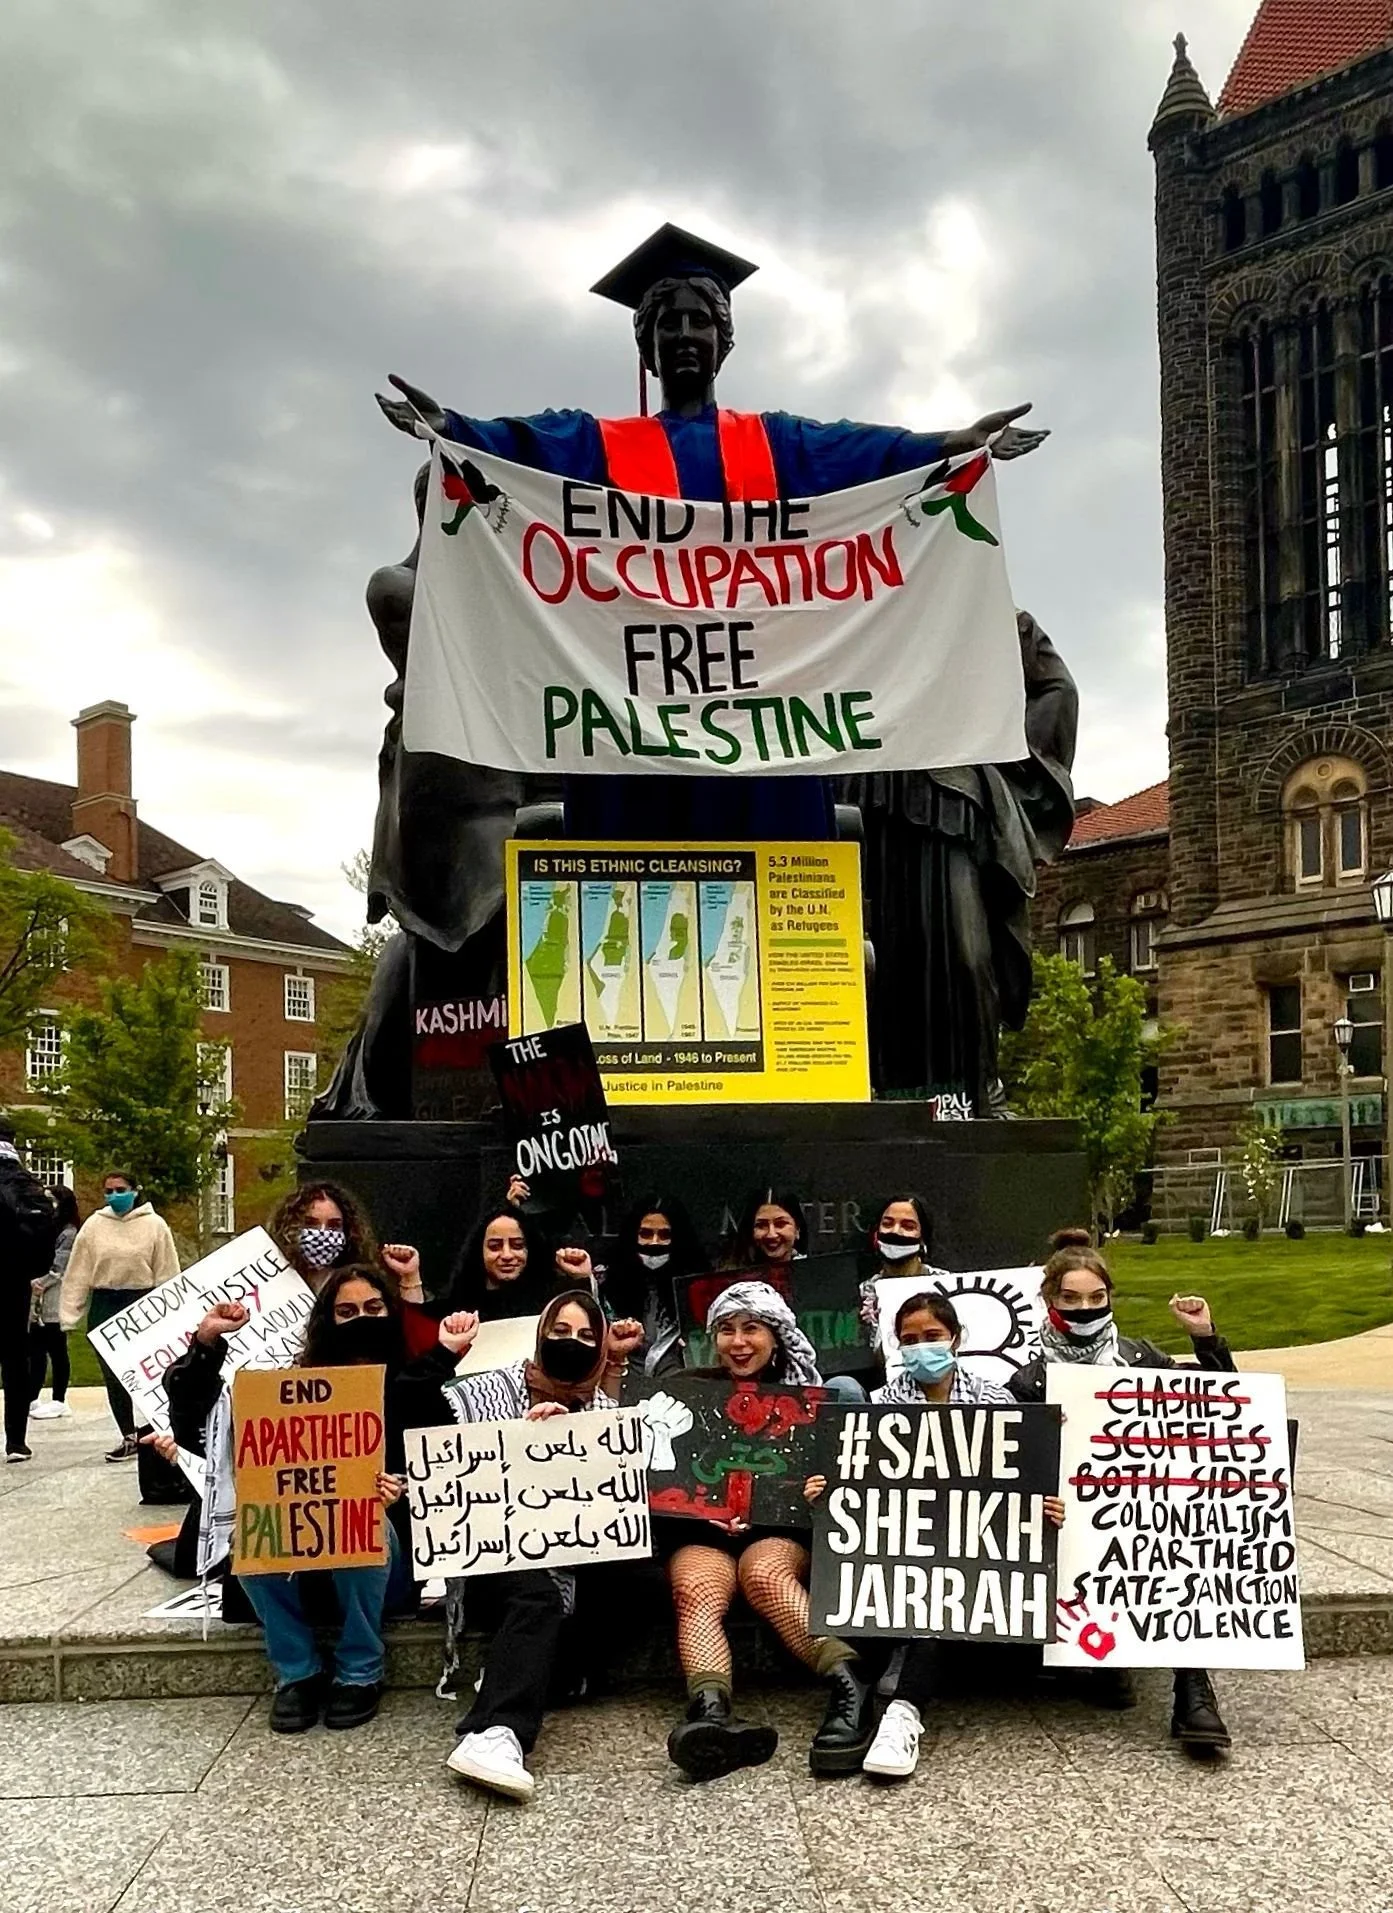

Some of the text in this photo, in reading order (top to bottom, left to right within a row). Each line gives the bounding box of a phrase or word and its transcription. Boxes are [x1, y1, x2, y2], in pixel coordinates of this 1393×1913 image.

[562, 481, 694, 543] END
[523, 522, 904, 608] OCCUPATION
[624, 622, 758, 696] FREE
[544, 686, 882, 764] PALESTINE
[534, 859, 742, 873] IS THIS ETHNIC CLEANSING?
[769, 856, 829, 867] 5.3 Million
[769, 872, 836, 883] Palestinians
[769, 887, 845, 899] are Classified
[770, 904, 831, 917] by the U.N.
[771, 920, 839, 933] as Refugees
[505, 1036, 547, 1063] THE
[621, 1053, 632, 1064] of
[635, 1052, 662, 1064] Land
[701, 1052, 712, 1063] to
[715, 1051, 757, 1063] Present
[603, 1080, 723, 1091] Justice in Palestine
[540, 1109, 561, 1126] IS
[249, 1291, 317, 1342] WOULD
[279, 1379, 332, 1405] END
[1107, 1376, 1242, 1421] CLASHES
[239, 1411, 383, 1469] APARTHEID
[407, 1412, 643, 1481] الله يلعن إسرائيل
[837, 1409, 1023, 1480] #SAVE
[1092, 1419, 1266, 1462] SCUFFLES
[277, 1465, 337, 1495] FREE
[412, 1460, 646, 1527] الله يلعن إسرائيل
[1076, 1462, 1288, 1510] BOTH SIDES
[241, 1497, 383, 1560] PALESTINE
[415, 1508, 647, 1570] الله يلعن إسرائيل
[828, 1486, 1043, 1563] SHEIKH
[1091, 1502, 1291, 1543] COLONIALISM
[1098, 1535, 1295, 1574] APARTHEID
[825, 1562, 1047, 1640] JARRAH
[1073, 1572, 1297, 1608] STATE-SANCTION
[1128, 1609, 1294, 1642] VIOLENCE
